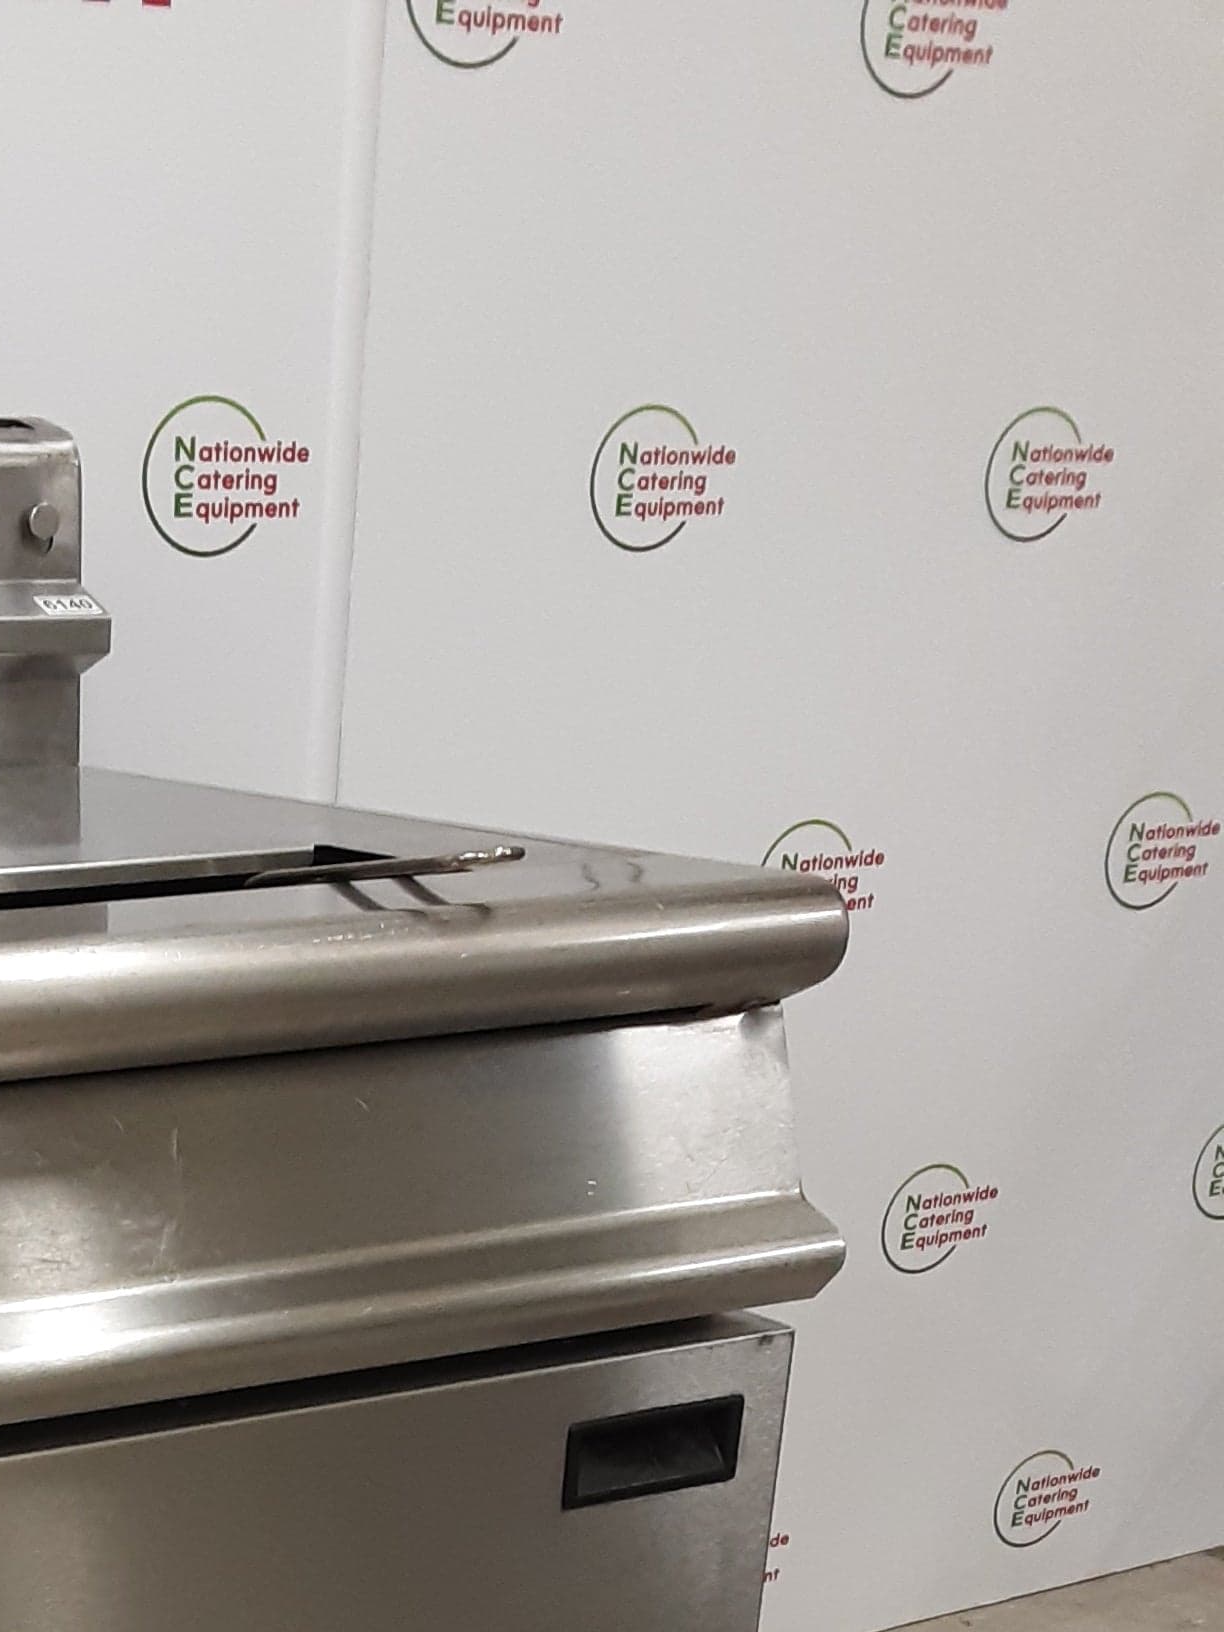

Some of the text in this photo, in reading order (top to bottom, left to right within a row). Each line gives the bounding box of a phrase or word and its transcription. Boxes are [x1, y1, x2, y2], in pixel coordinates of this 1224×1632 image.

[435, 0, 563, 35] Equipment
[889, 5, 978, 42] Catering
[884, 32, 994, 68] Equipment
[174, 435, 310, 463] Nationwide
[618, 441, 737, 465] Nationwide
[1011, 440, 1115, 463] Nationwide
[174, 464, 278, 496] Catering
[617, 467, 707, 496] Catering
[1008, 464, 1087, 491] Catering
[173, 493, 300, 524] Equipment
[615, 493, 725, 521] Equipment
[1005, 488, 1102, 514] Equipment
[42, 598, 93, 610] 6140
[1128, 820, 1222, 842] Nationwide
[781, 848, 885, 873] Nationwide
[1126, 842, 1197, 862] Catering
[1122, 861, 1209, 885] Equipment
[905, 1185, 999, 1213] Nationwide
[903, 1209, 975, 1231] Catering
[899, 1224, 988, 1251] Equipment
[1016, 1465, 1101, 1495] Nationwide
[1013, 1487, 1079, 1510] Catering
[1010, 1500, 1090, 1528] Equipment
